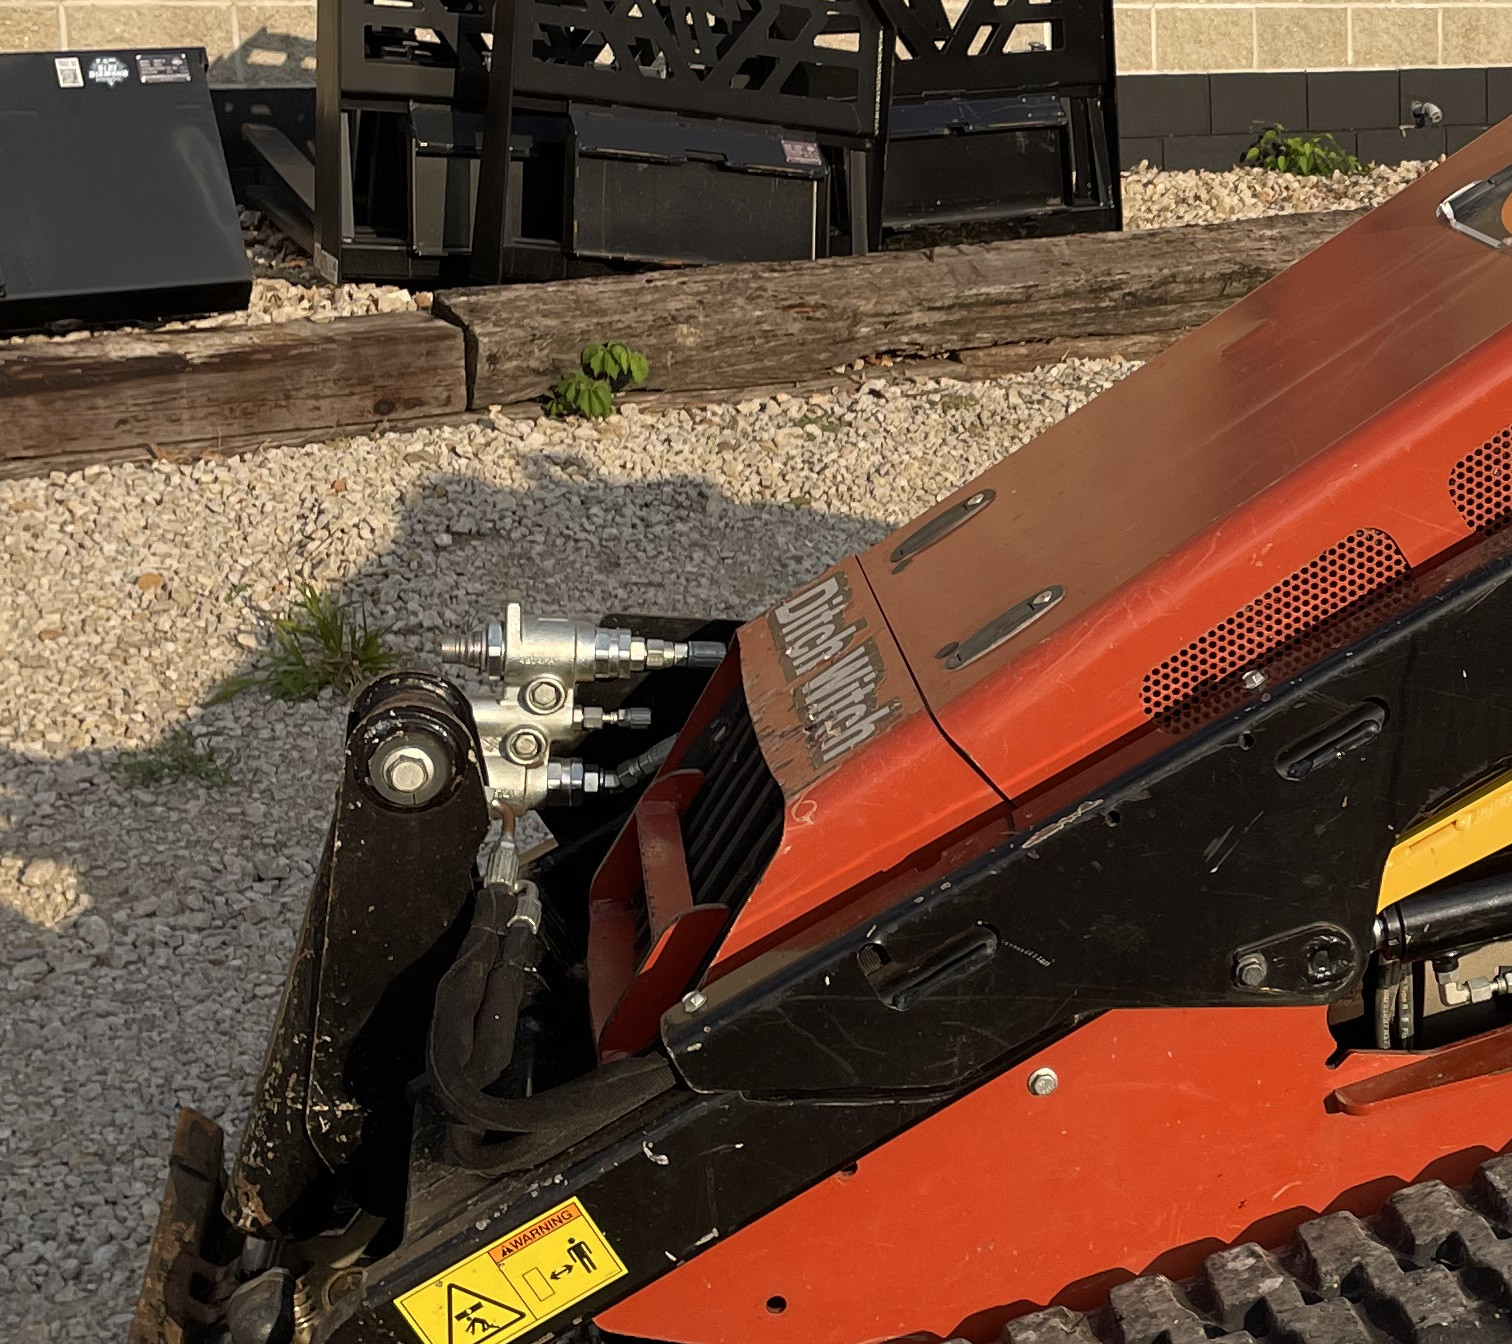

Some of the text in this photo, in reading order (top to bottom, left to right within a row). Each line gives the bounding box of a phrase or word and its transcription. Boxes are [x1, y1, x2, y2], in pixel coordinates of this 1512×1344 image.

[775, 577, 857, 676] Ditch
[802, 645, 890, 762] Witch
[507, 1209, 574, 1252] WARNING
